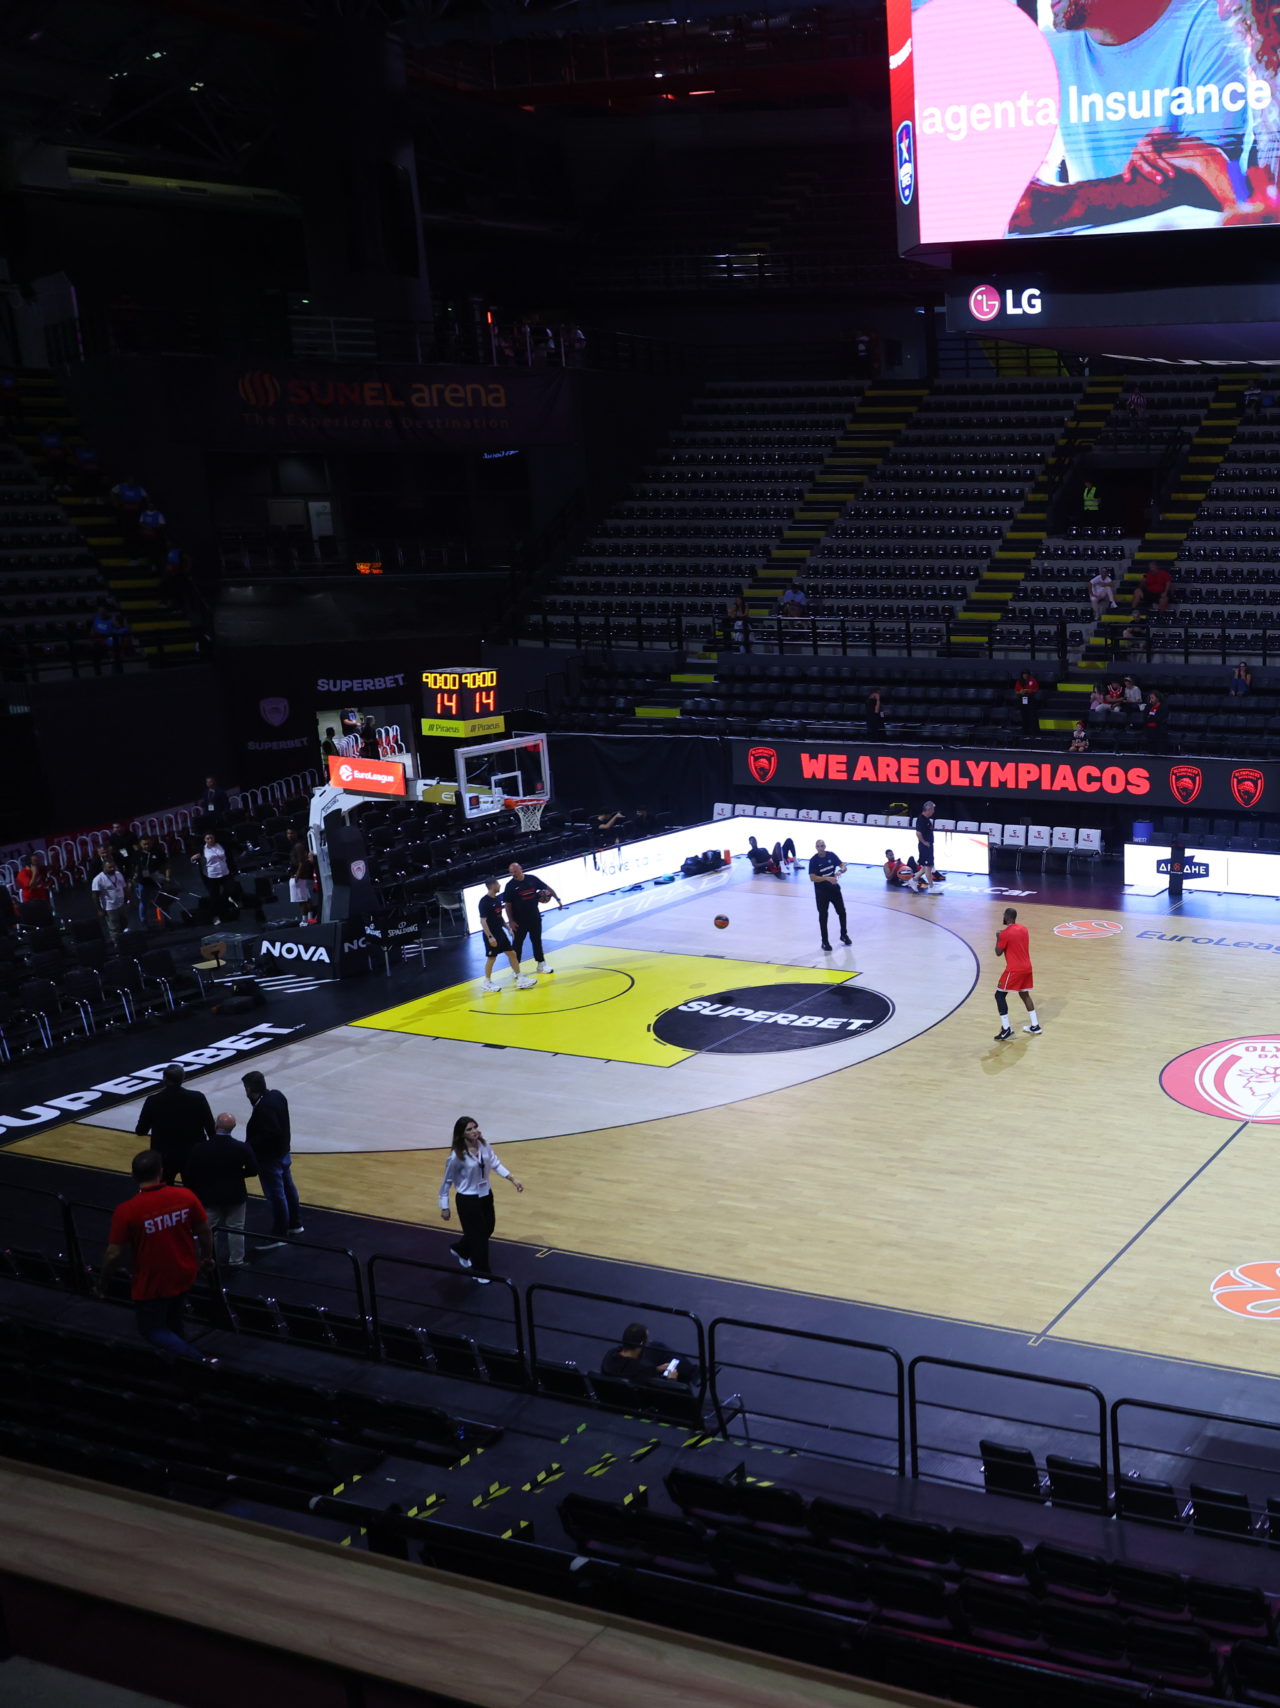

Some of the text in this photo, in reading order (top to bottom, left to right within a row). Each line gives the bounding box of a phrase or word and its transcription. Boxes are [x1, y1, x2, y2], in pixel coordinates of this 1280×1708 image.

[914, 77, 1272, 141] agenta Insurance
[1006, 288, 1042, 315] LG
[287, 380, 507, 408] SUNEL arena
[287, 413, 393, 430] Experience
[401, 415, 511, 431] Destination
[316, 673, 405, 693] SUPERBET
[422, 670, 497, 690] 90:00 90:00
[436, 692, 457, 716] 14
[475, 690, 495, 714] 14
[247, 736, 310, 751] SUPERBET
[353, 769, 394, 784] EuroLeague
[800, 754, 1151, 795] WE ARE OLYMPIACOS
[1159, 863, 1207, 875] ΔΔΗΕ
[940, 883, 1038, 897] lexCar
[387, 923, 419, 938] SPALDING
[260, 940, 331, 964] NOVA
[677, 1000, 874, 1031] SUPERBET
[0, 1022, 295, 1136] UPERBET
[144, 1208, 191, 1235] STAFF
